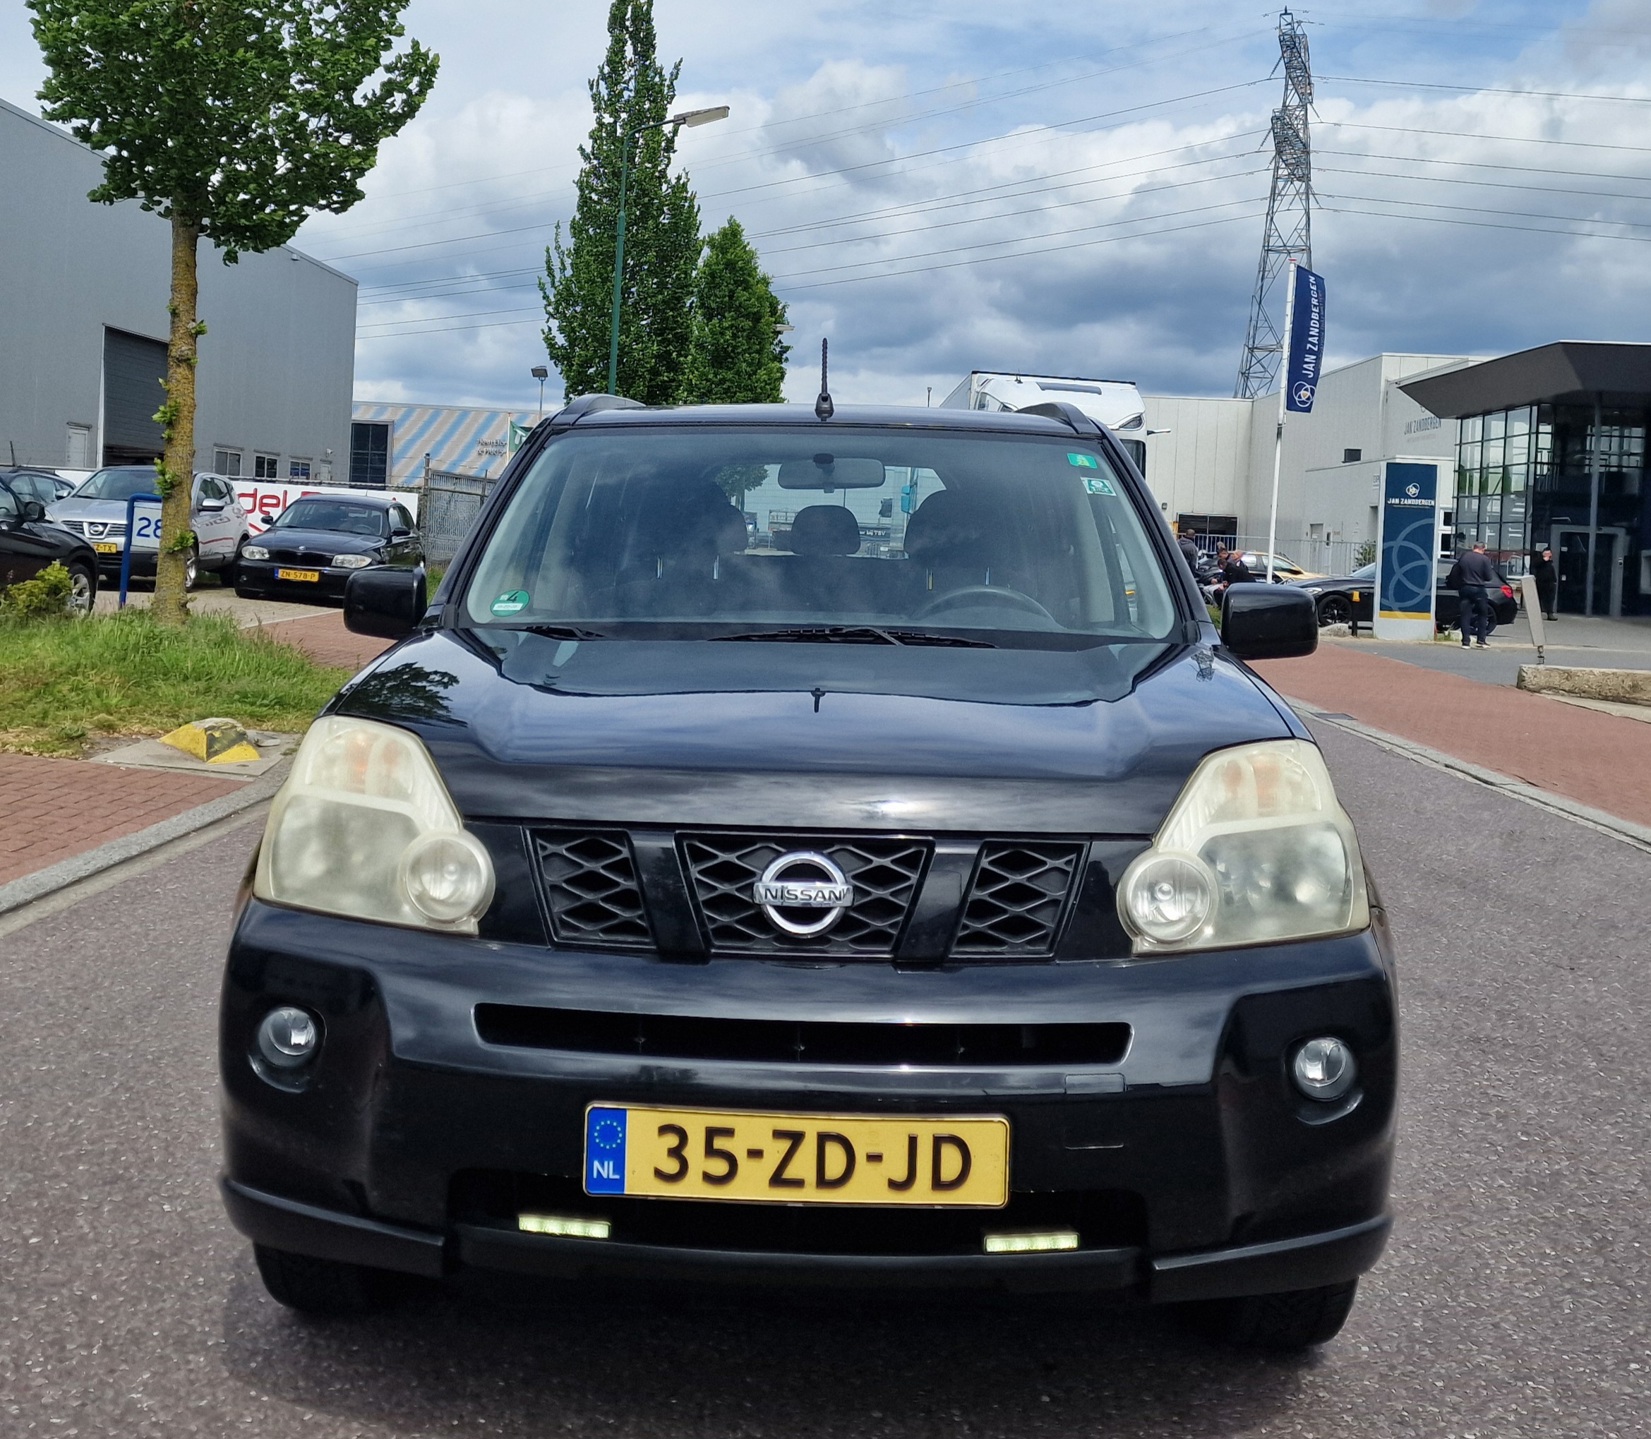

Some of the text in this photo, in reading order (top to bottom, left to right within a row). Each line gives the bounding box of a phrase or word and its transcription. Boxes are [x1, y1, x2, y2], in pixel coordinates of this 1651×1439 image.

[1302, 275, 1320, 379] JAN ZANDBERGEN
[764, 885, 843, 902] NISSAN
[592, 1123, 972, 1192] NL 35-ZD-JD
